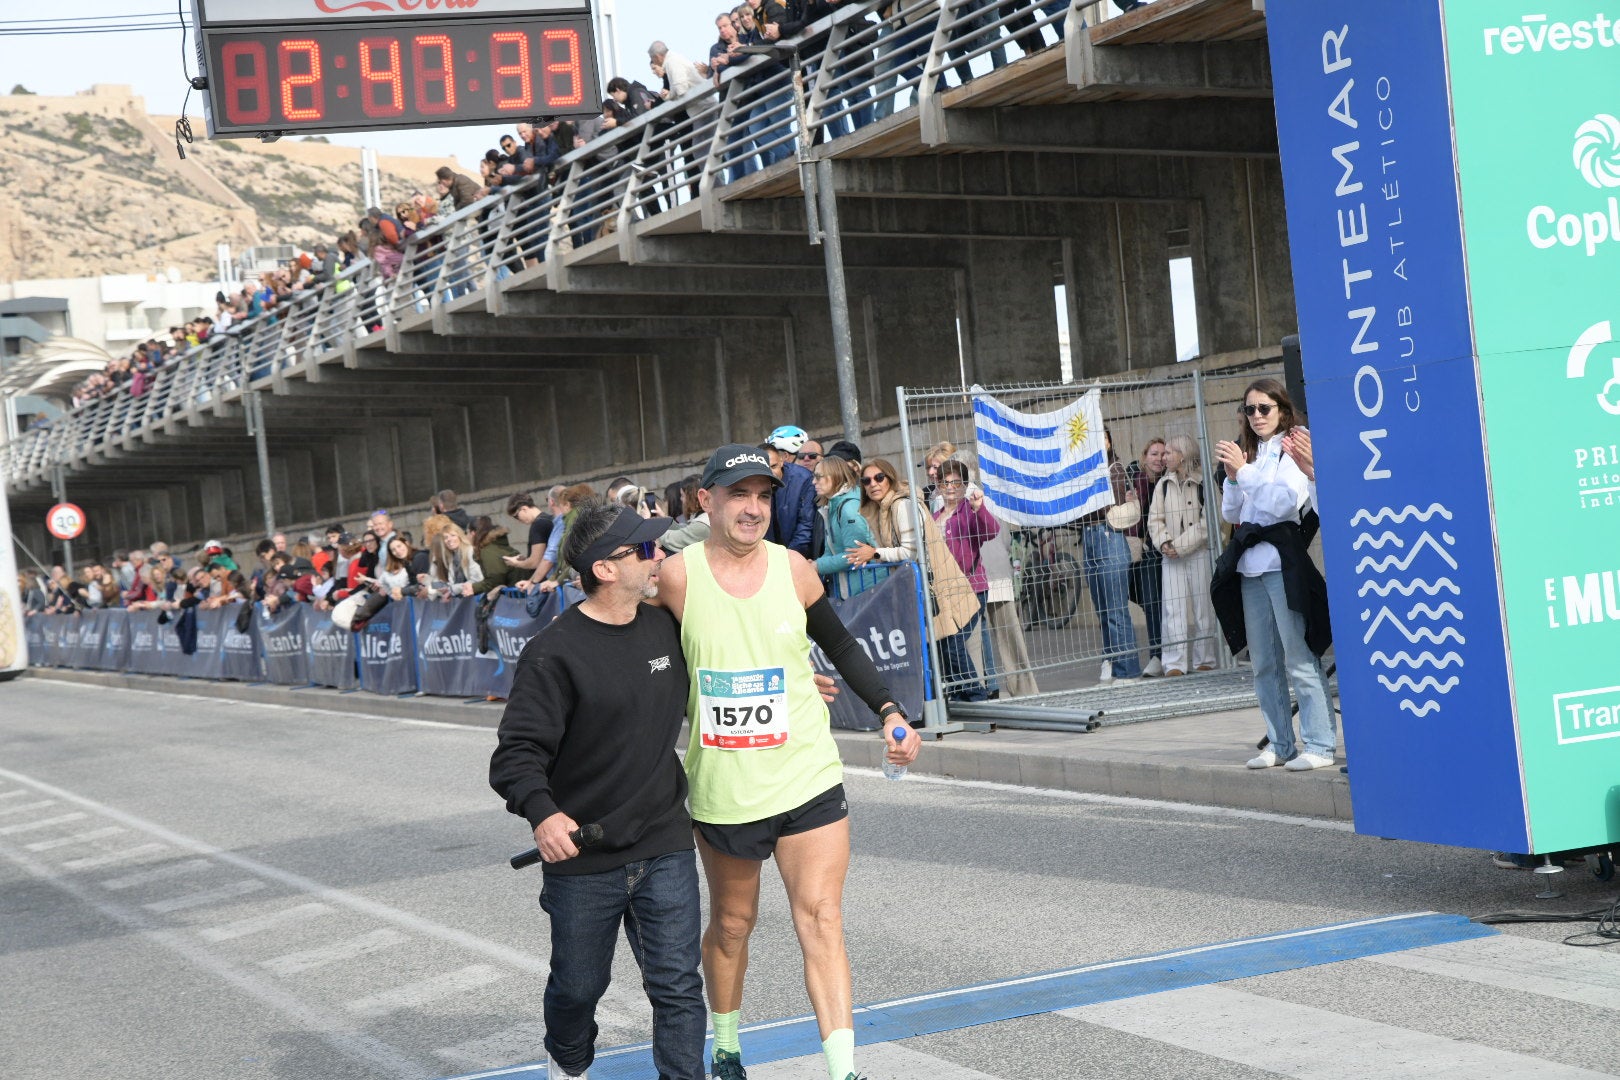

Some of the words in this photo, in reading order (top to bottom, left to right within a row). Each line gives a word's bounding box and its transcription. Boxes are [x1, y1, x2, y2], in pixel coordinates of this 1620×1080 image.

[1483, 13, 1620, 56] revest
[280, 29, 583, 121] 2:47:33
[1376, 76, 1408, 281] ATLÉTICO
[1321, 24, 1392, 481] MONTEMAR
[1397, 305, 1420, 412] CLUB
[56, 515, 76, 529] 30
[1580, 492, 1620, 509] ind
[496, 628, 534, 657] Alica
[712, 704, 773, 727] 1570
